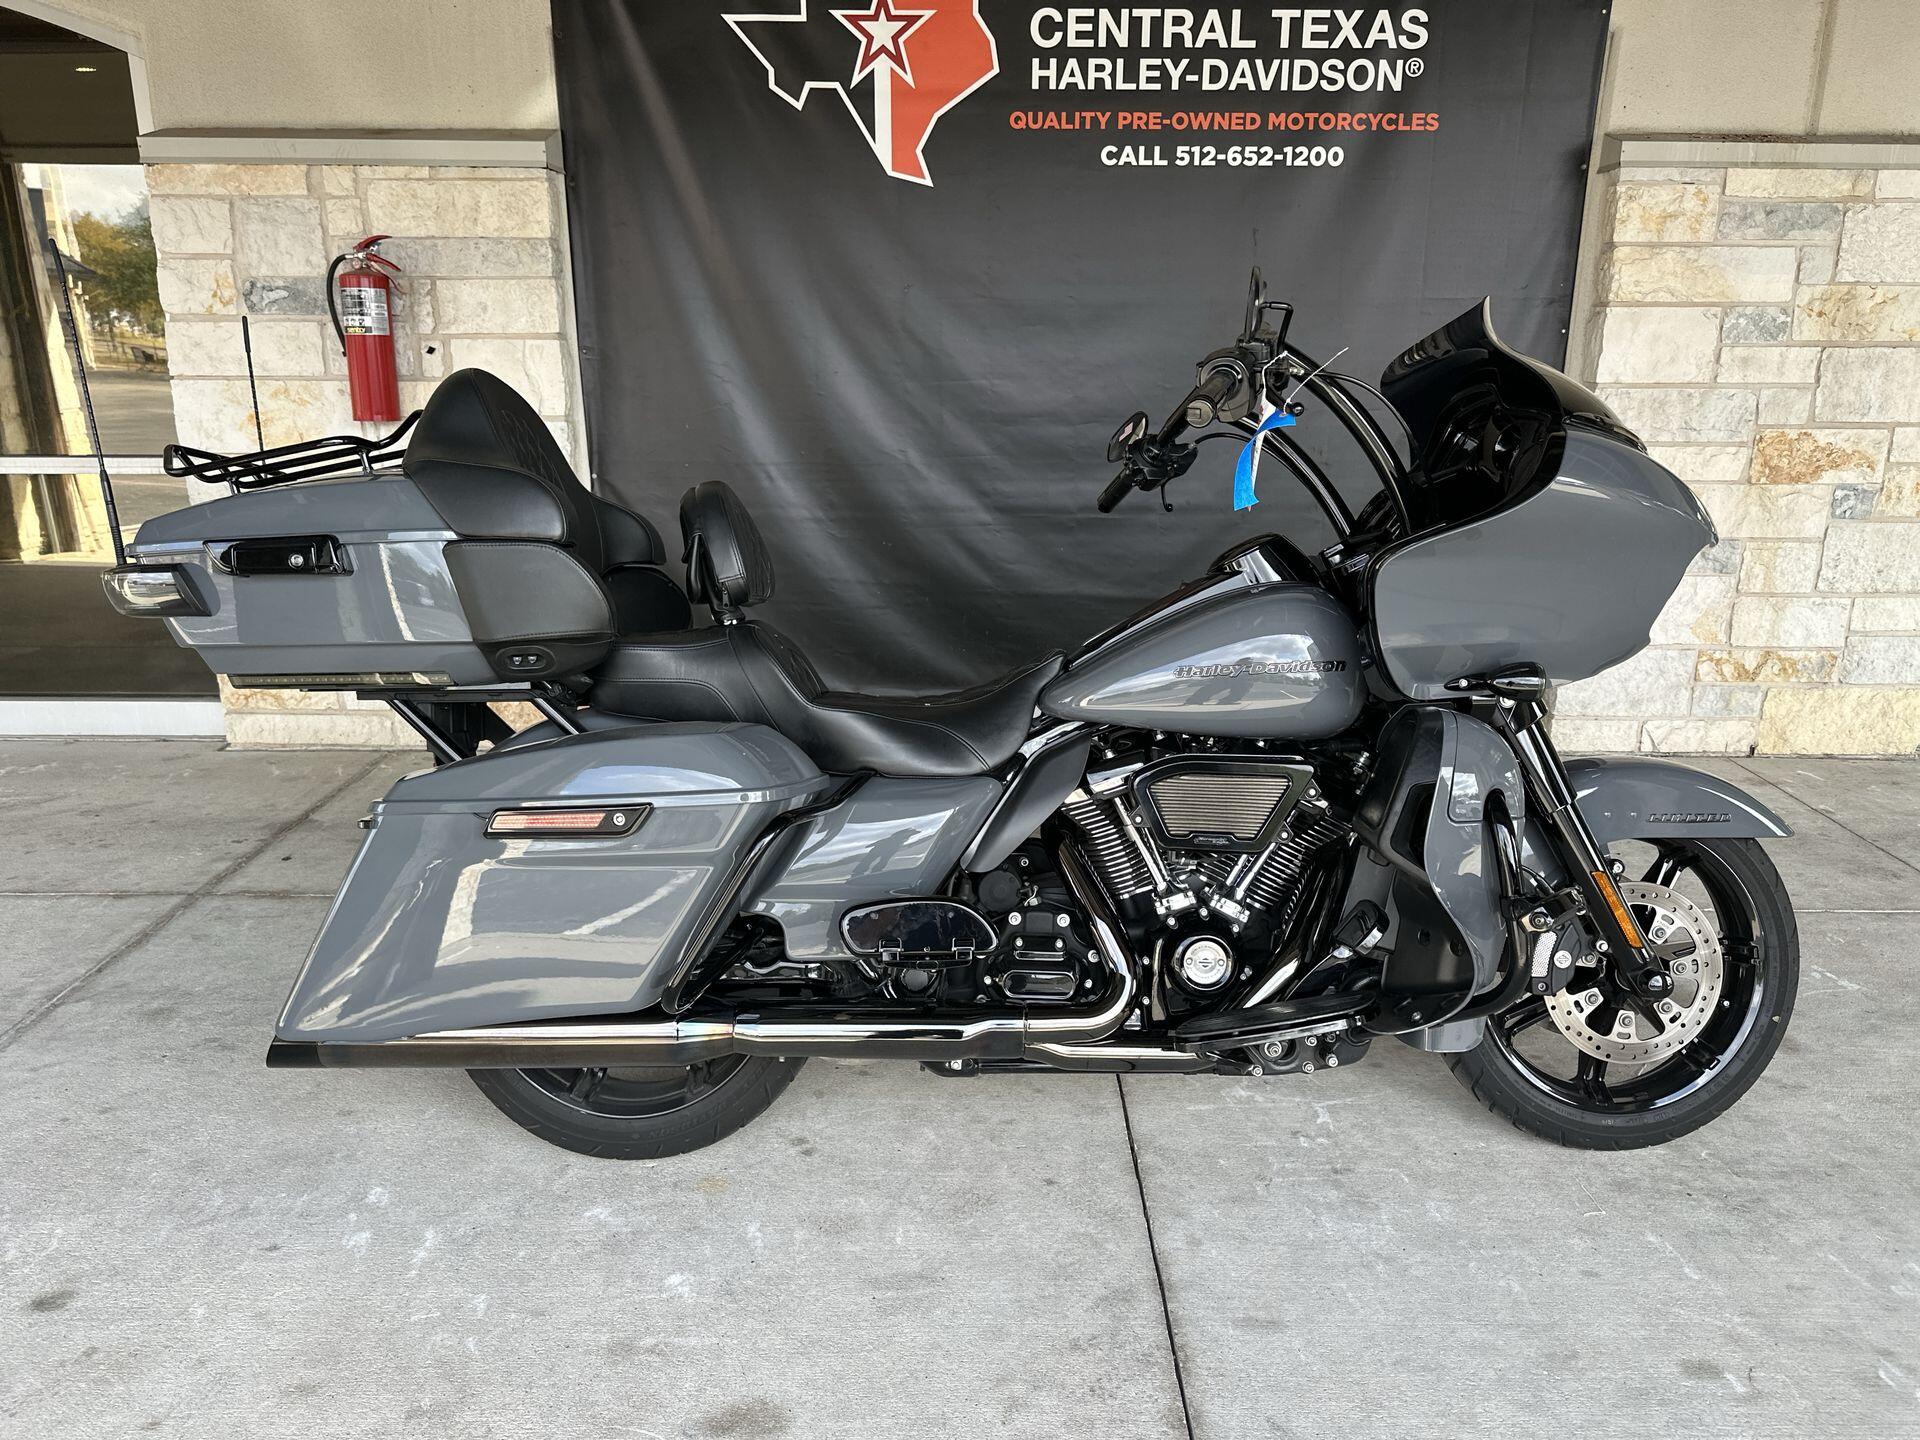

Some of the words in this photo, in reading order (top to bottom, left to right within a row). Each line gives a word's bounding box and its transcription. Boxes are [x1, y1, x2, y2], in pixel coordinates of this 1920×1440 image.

[1030, 7, 1257, 49] CENTRAL
[1271, 8, 1429, 50] TEXAS
[1009, 111, 1112, 131] QUALITY
[1117, 111, 1262, 131] PRE-OWNED
[1267, 112, 1440, 132] MOTORCYCLES
[1100, 145, 1169, 167] CALL
[1174, 145, 1345, 168] 512-652-1200
[1174, 660, 1348, 678] Harley-Davidson
